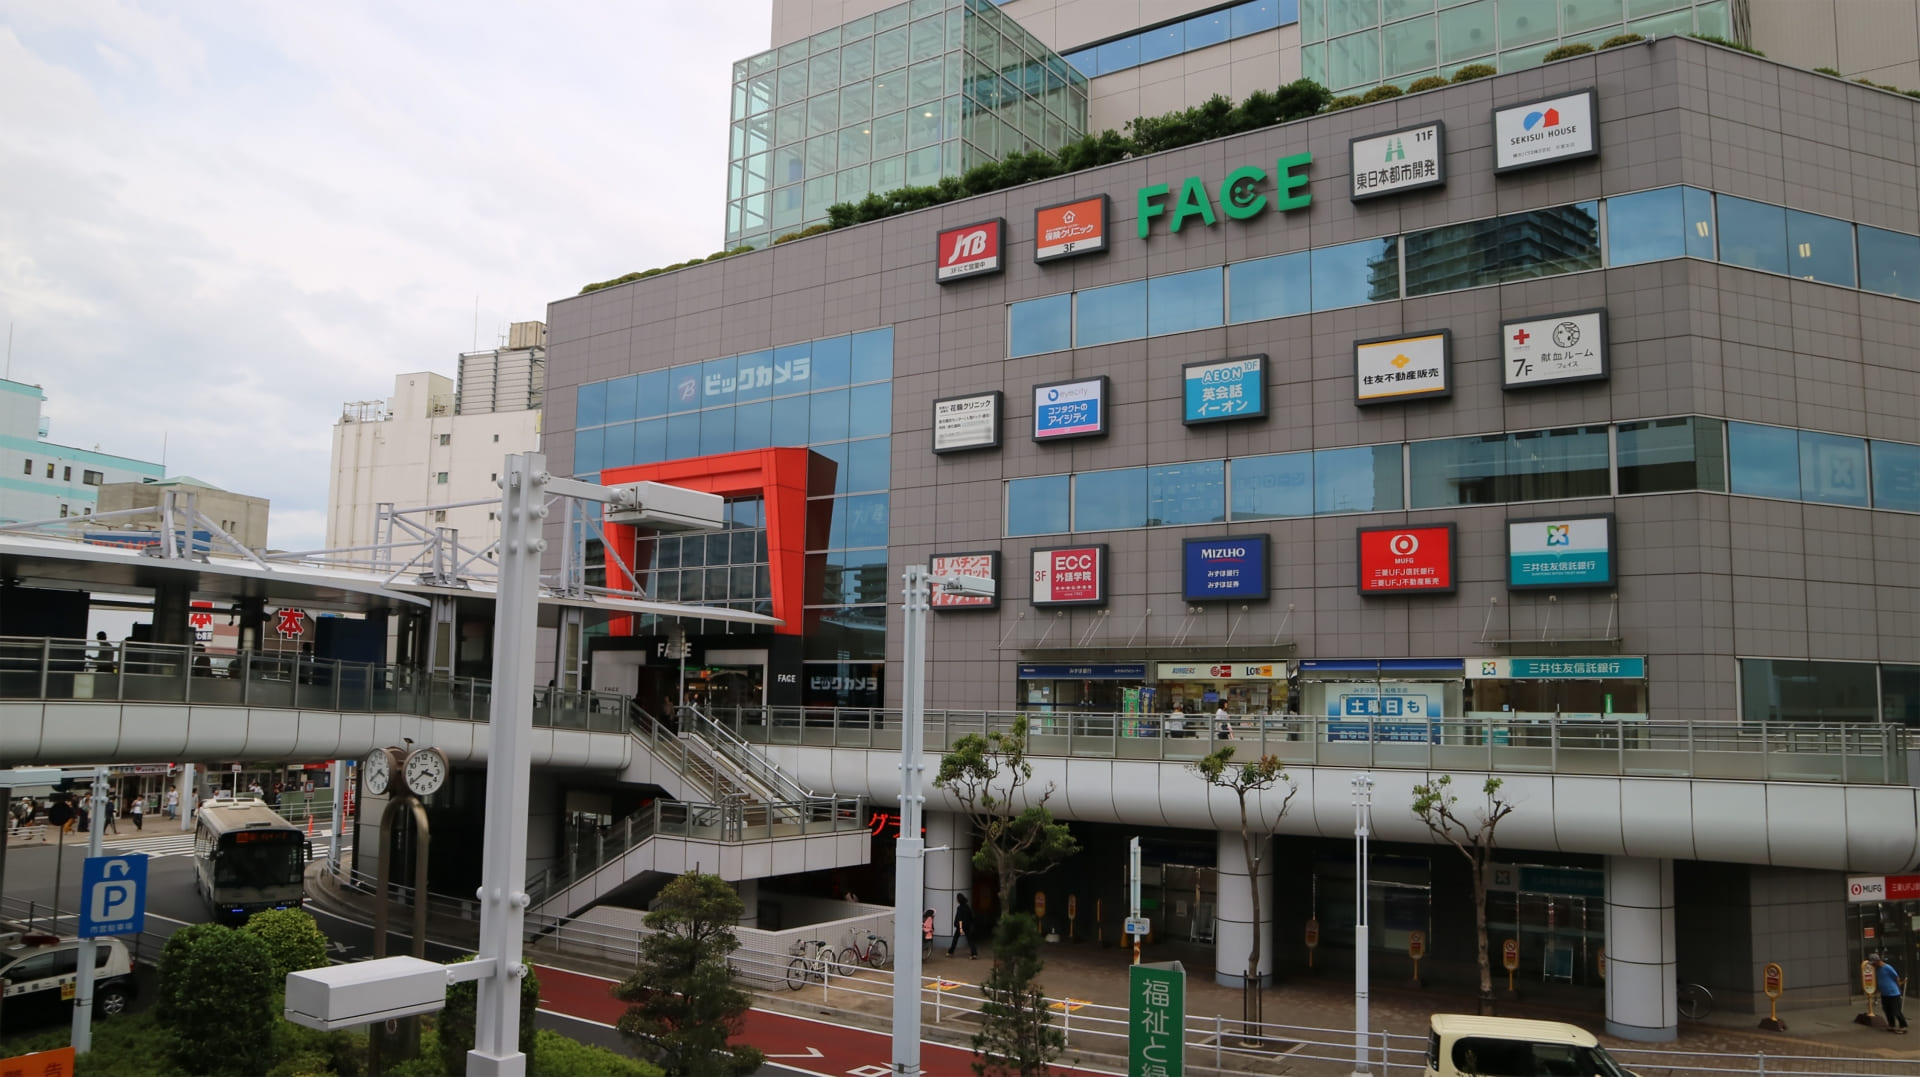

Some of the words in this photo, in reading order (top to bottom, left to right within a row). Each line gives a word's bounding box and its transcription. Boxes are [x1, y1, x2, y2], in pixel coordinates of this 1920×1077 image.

[1415, 129, 1434, 143] 11F
[1510, 132, 1545, 146] SEKISUI
[1547, 125, 1577, 138] HOUSE
[1356, 159, 1436, 190] 東日本都市開発
[1138, 153, 1312, 239] FACE
[1045, 224, 1094, 242] 保険クリニック
[948, 230, 988, 265] JTB
[1063, 243, 1076, 253] 3F
[1541, 349, 1594, 362] 献血ルーム
[1244, 361, 1258, 372] 10F
[1512, 358, 1533, 377] 7F
[705, 357, 810, 396] ビックカメラ
[1202, 366, 1243, 384] AEON
[1363, 368, 1440, 385] 住友不動産販売
[1202, 384, 1243, 402] 英会話
[1198, 399, 1248, 416] イーオン
[1048, 413, 1087, 426] アイシティ
[1201, 547, 1246, 560] MIZUHO
[950, 557, 990, 569] パチンコ
[1055, 555, 1092, 571] ECC
[1522, 561, 1596, 573] 三井住友信託銀行
[1034, 570, 1047, 582] 3F
[1055, 571, 1092, 582] 外語学院
[1207, 569, 1240, 578] みずほ銀行
[1375, 568, 1435, 577] 三菱UFJ信託銀行
[1207, 580, 1240, 589] みずほ証券
[277, 608, 304, 639] 本
[657, 643, 692, 658] FAE
[1529, 662, 1620, 674] 三井住友信託銀行
[778, 675, 796, 683] FACE
[811, 677, 878, 691] ビックカメラ
[1351, 699, 1420, 714] 土曜日も
[1863, 884, 1883, 893] MUFG
[102, 885, 128, 917] P
